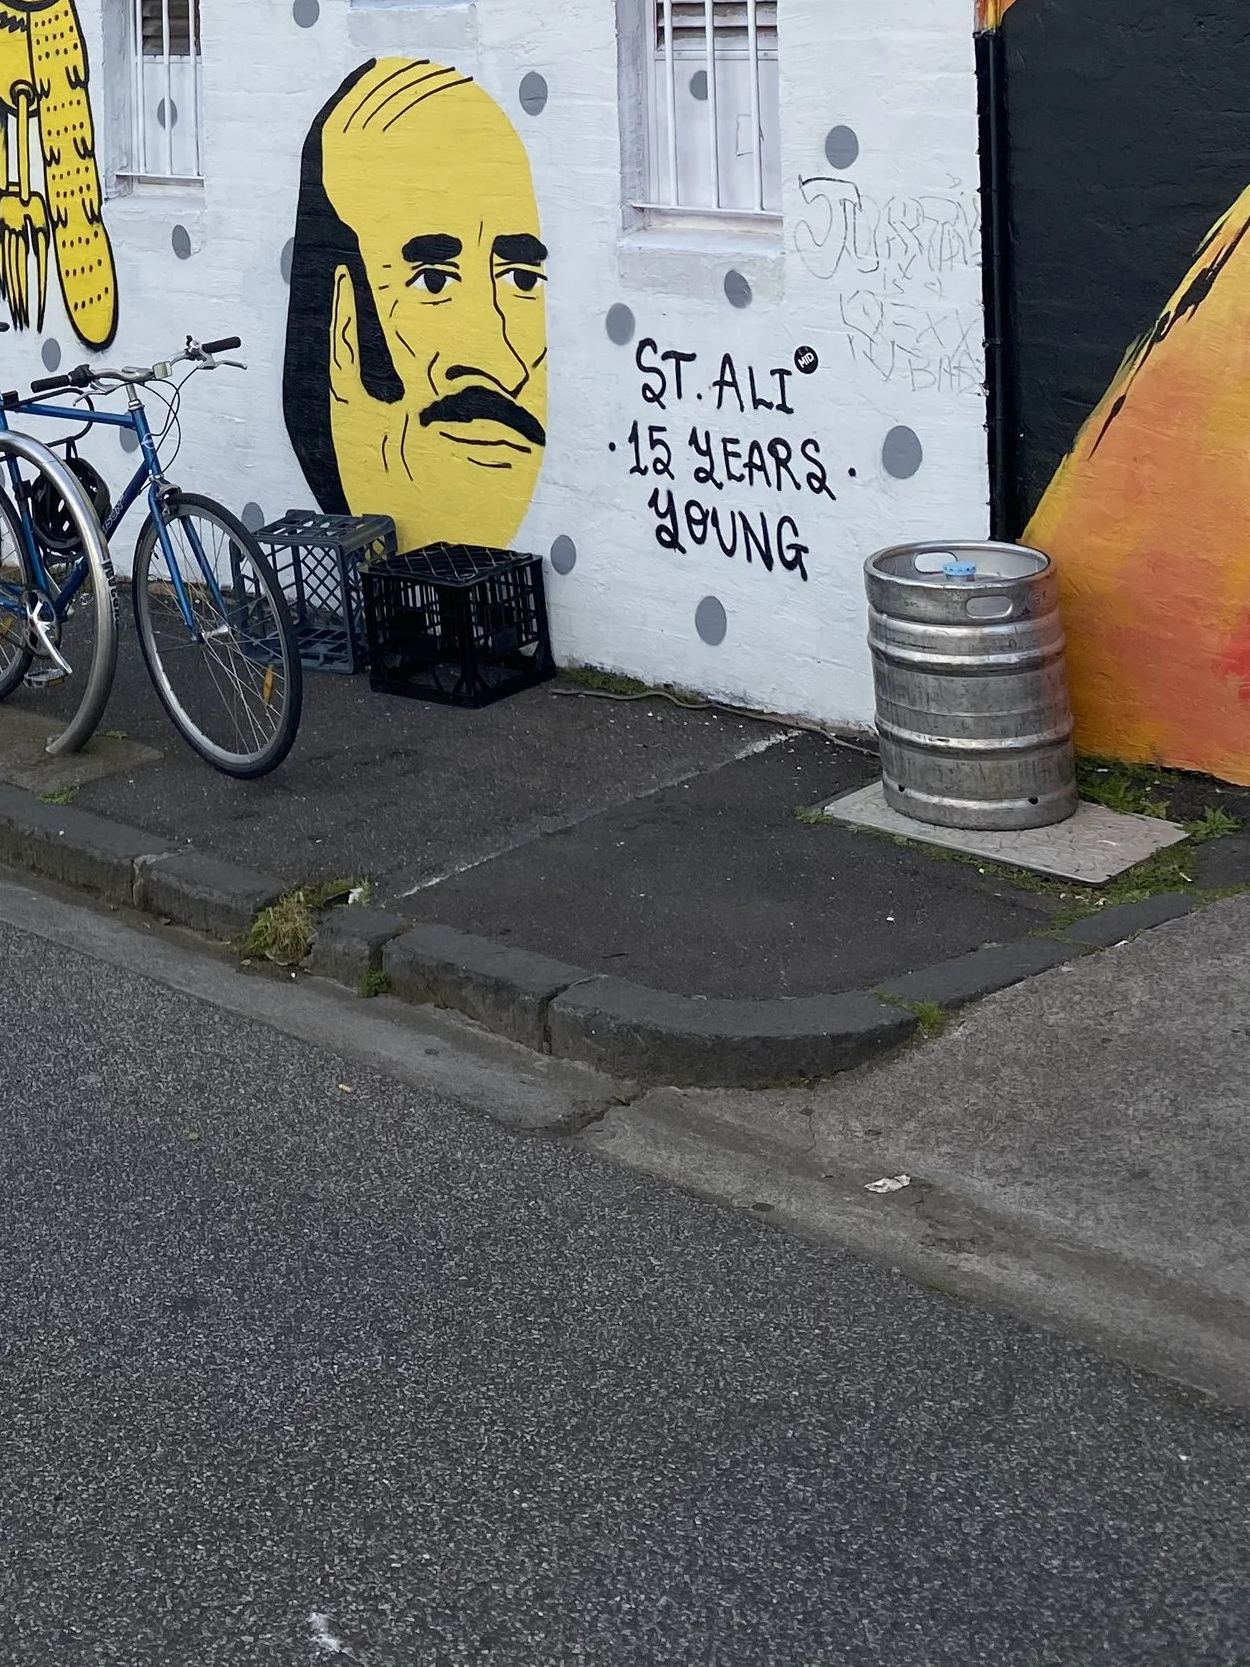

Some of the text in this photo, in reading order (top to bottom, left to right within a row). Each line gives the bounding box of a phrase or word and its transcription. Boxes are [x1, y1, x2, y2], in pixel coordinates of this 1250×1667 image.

[628, 420, 836, 501] 15 YEARS
[648, 487, 809, 582] YOUNG
